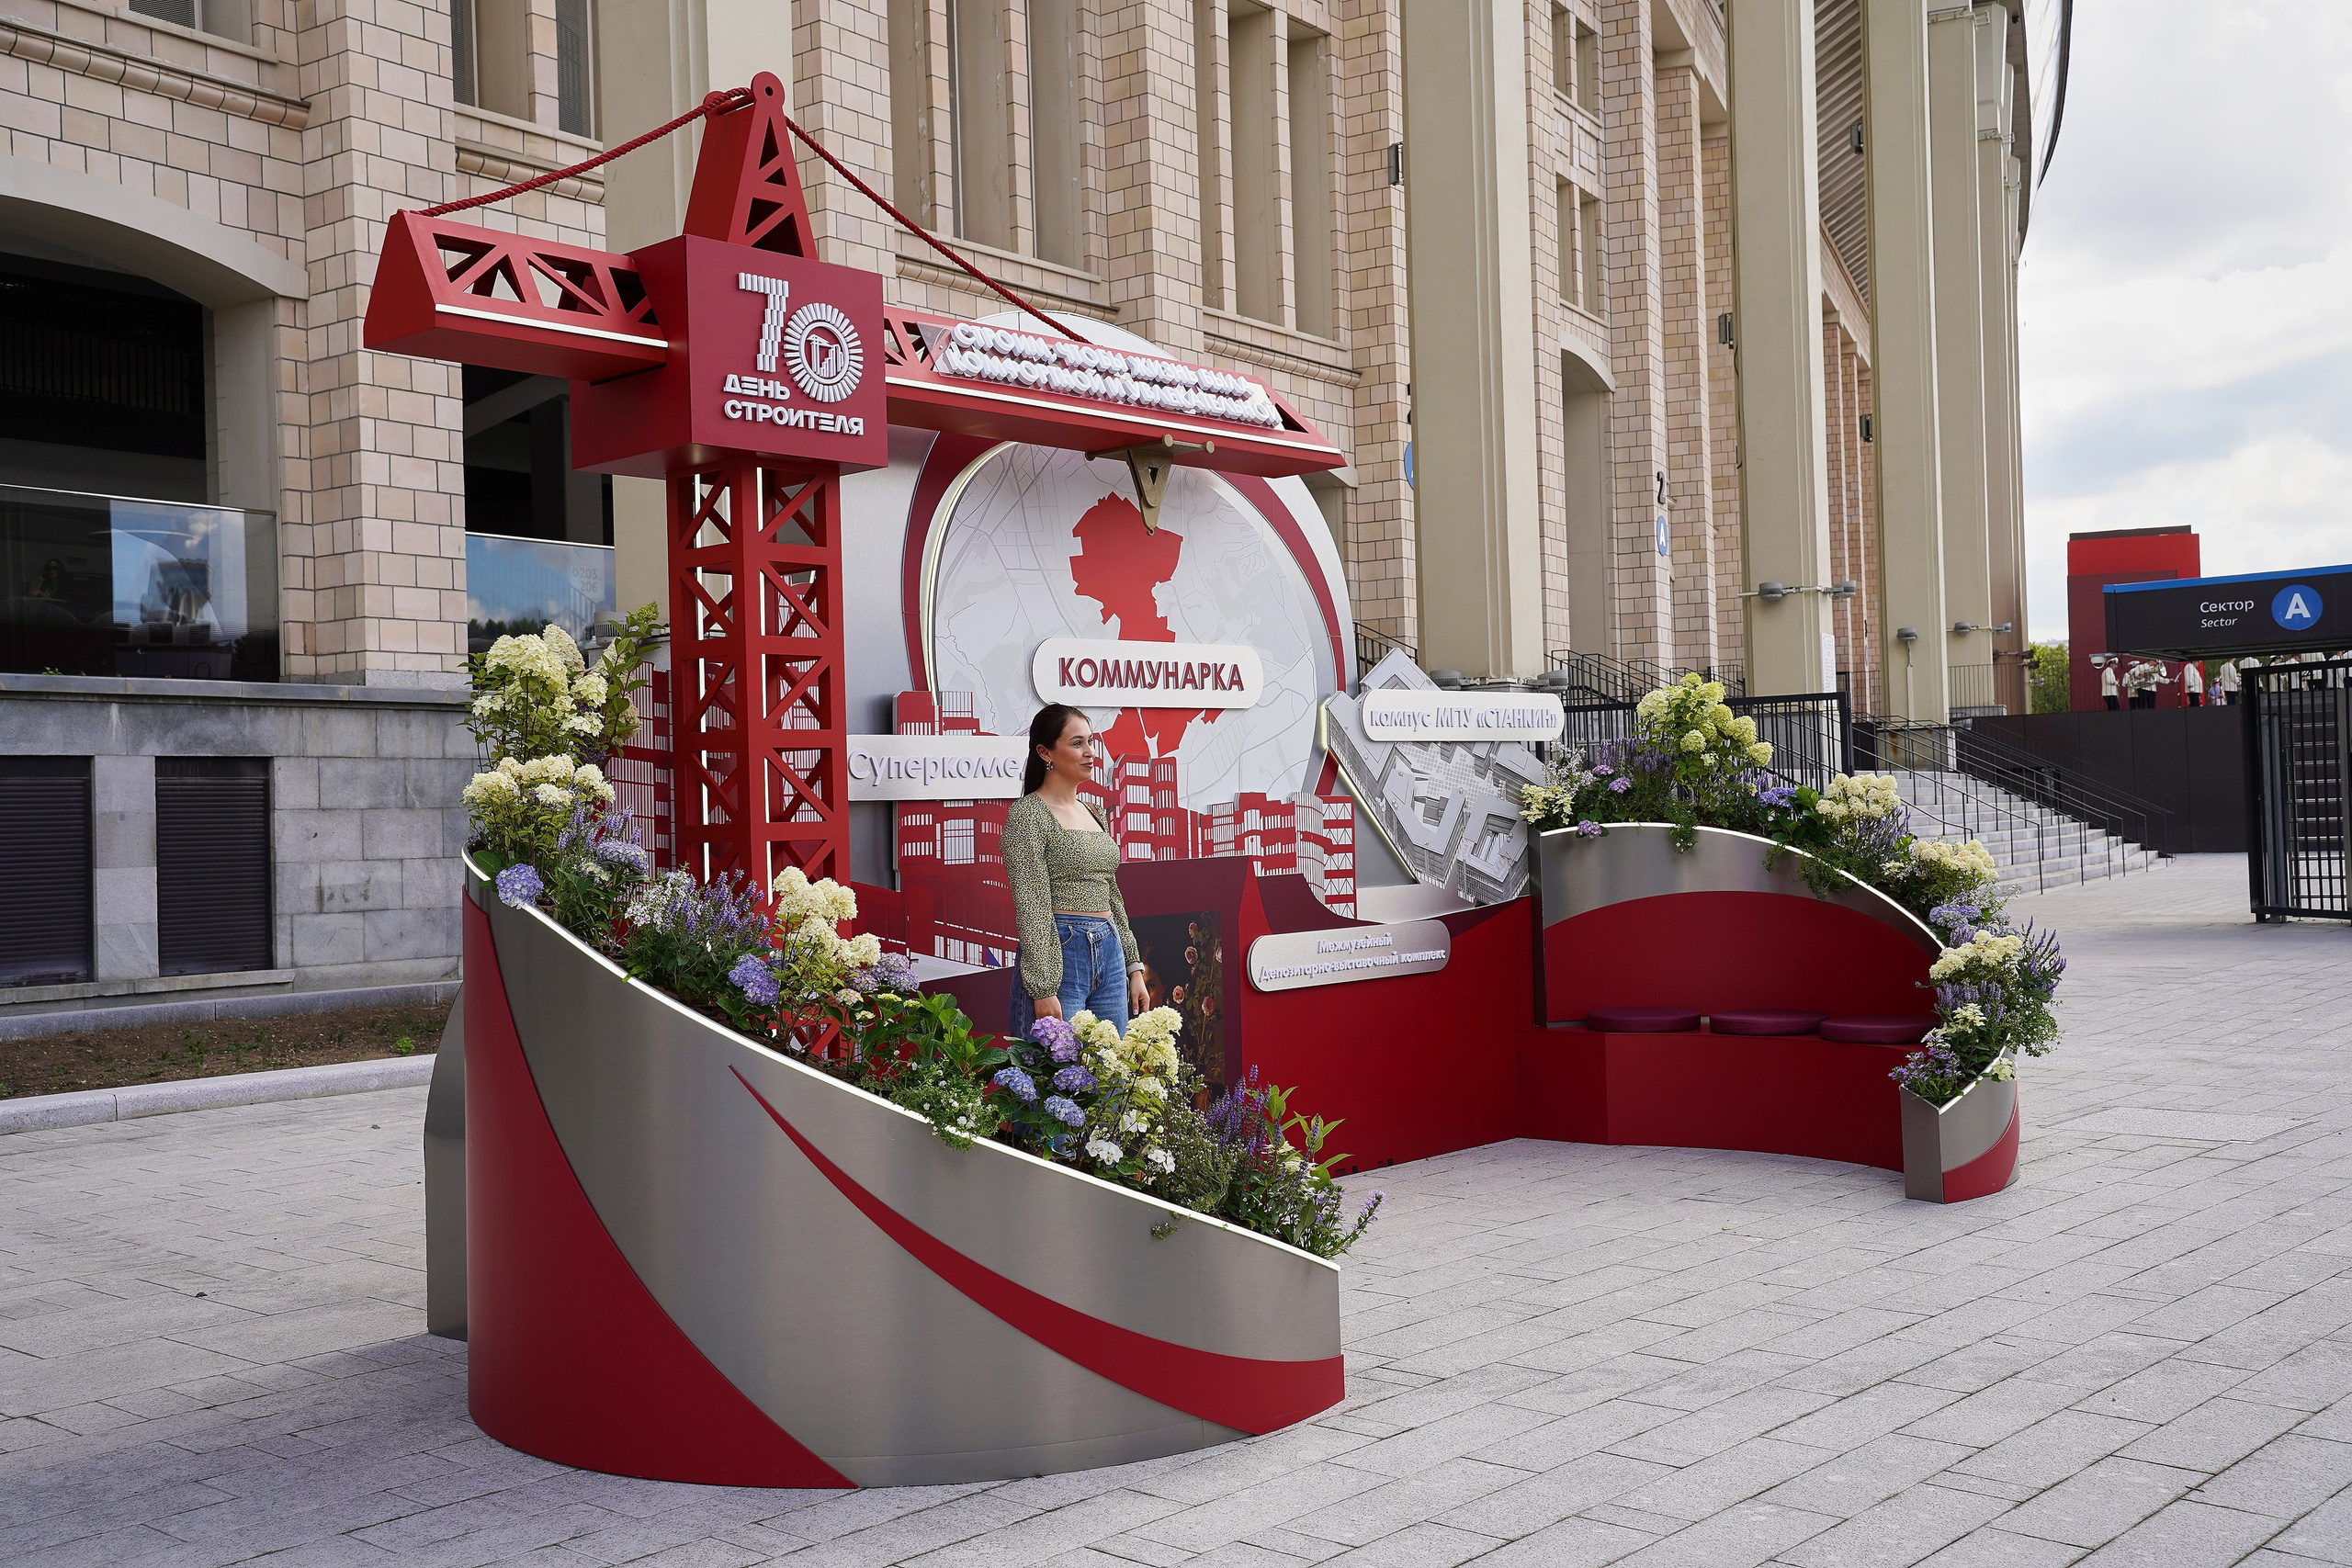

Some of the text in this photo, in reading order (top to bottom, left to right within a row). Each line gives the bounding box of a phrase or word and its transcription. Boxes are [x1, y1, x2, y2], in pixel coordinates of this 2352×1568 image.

[950, 322, 1255, 398] СТРОИМ, ЧТОБЫ ЖИЗНЬ БЫЛА
[723, 374, 790, 400] ДЕНЬ
[944, 341, 1283, 427] КОМФОРТНОЙ И УВЛЕКАТЕЛЬНОЙ
[724, 400, 865, 435] СТРОИТЕЛЯ
[1657, 470, 1666, 504] 2
[2199, 599, 2255, 614] Сектор
[2200, 617, 2238, 628] Sector
[1058, 657, 1245, 691] КОММУНАРКА
[1436, 707, 1474, 728] МГТУ
[1476, 707, 1557, 728] «СТАНКИН»
[1317, 931, 1393, 953] Межмузейный
[1259, 949, 1446, 982] Депозитарно-выставочный комплекс
